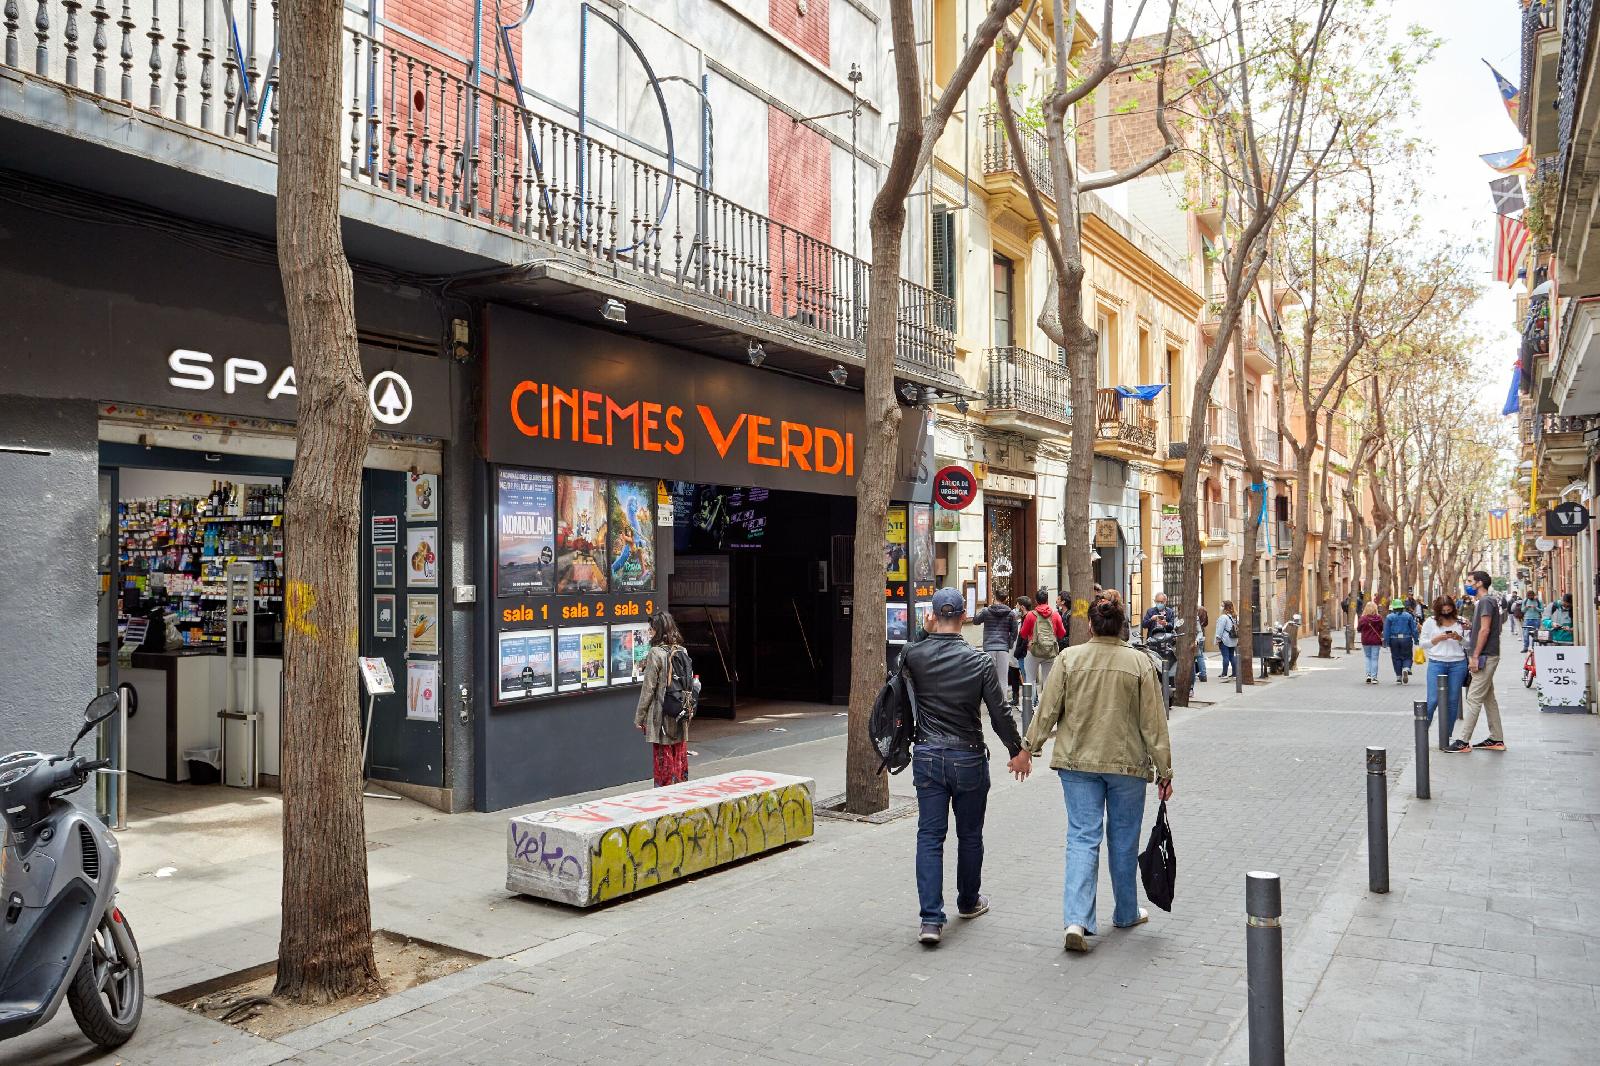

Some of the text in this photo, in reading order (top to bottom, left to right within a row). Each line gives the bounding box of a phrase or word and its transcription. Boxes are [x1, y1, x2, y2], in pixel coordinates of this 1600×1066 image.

[168, 349, 297, 400] SPA
[510, 380, 854, 476] CINEMES VERDI
[502, 514, 553, 535] NOMADLAND
[896, 586, 905, 597] 4
[503, 604, 548, 622] sala 1
[562, 602, 605, 619] sala 2
[614, 600, 653, 616] sala 3
